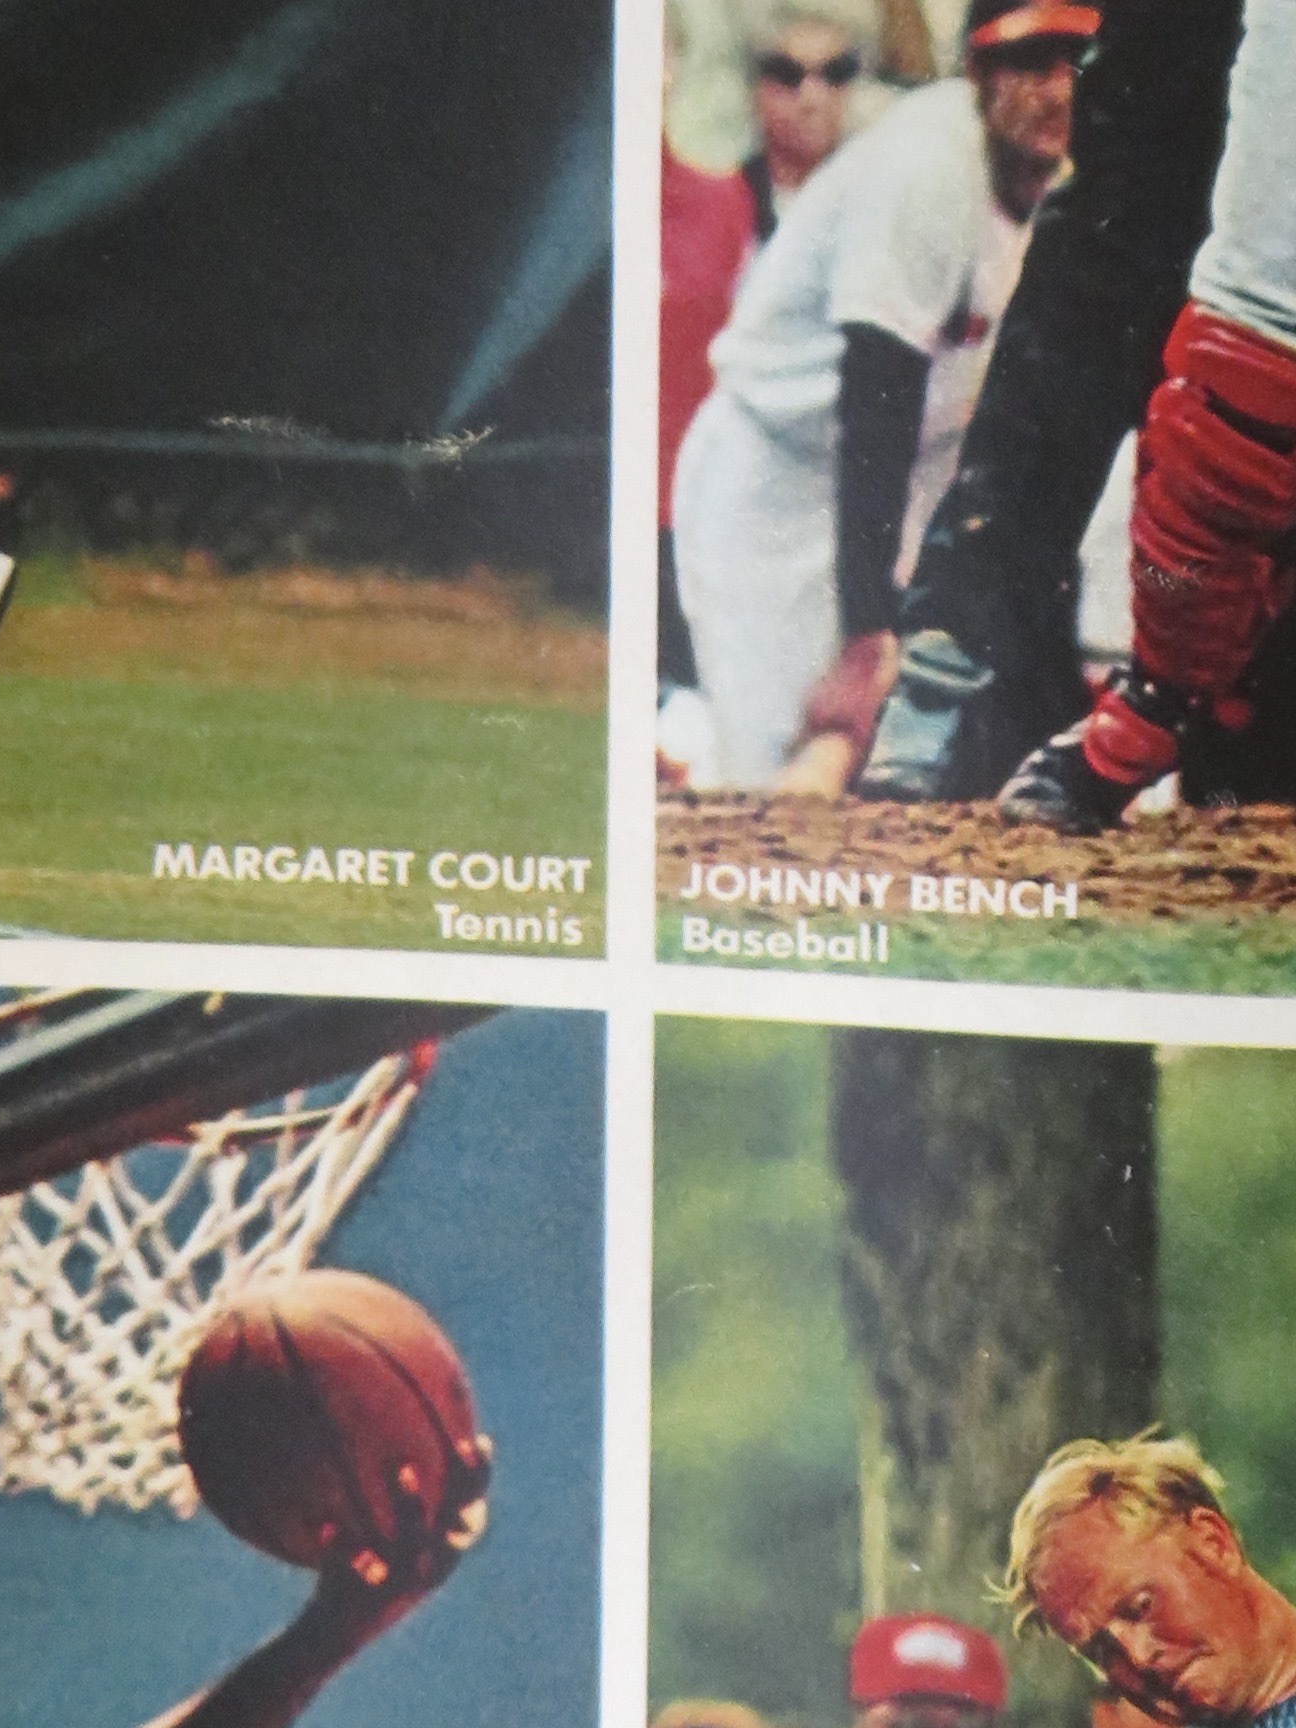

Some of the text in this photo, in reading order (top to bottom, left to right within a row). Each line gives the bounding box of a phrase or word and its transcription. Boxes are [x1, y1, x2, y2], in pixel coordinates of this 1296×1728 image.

[152, 843, 591, 893] MARGARET COURT
[681, 863, 1078, 919] JOHNNY BENCH
[434, 903, 583, 946] Tennis
[682, 915, 889, 963] Baseball
